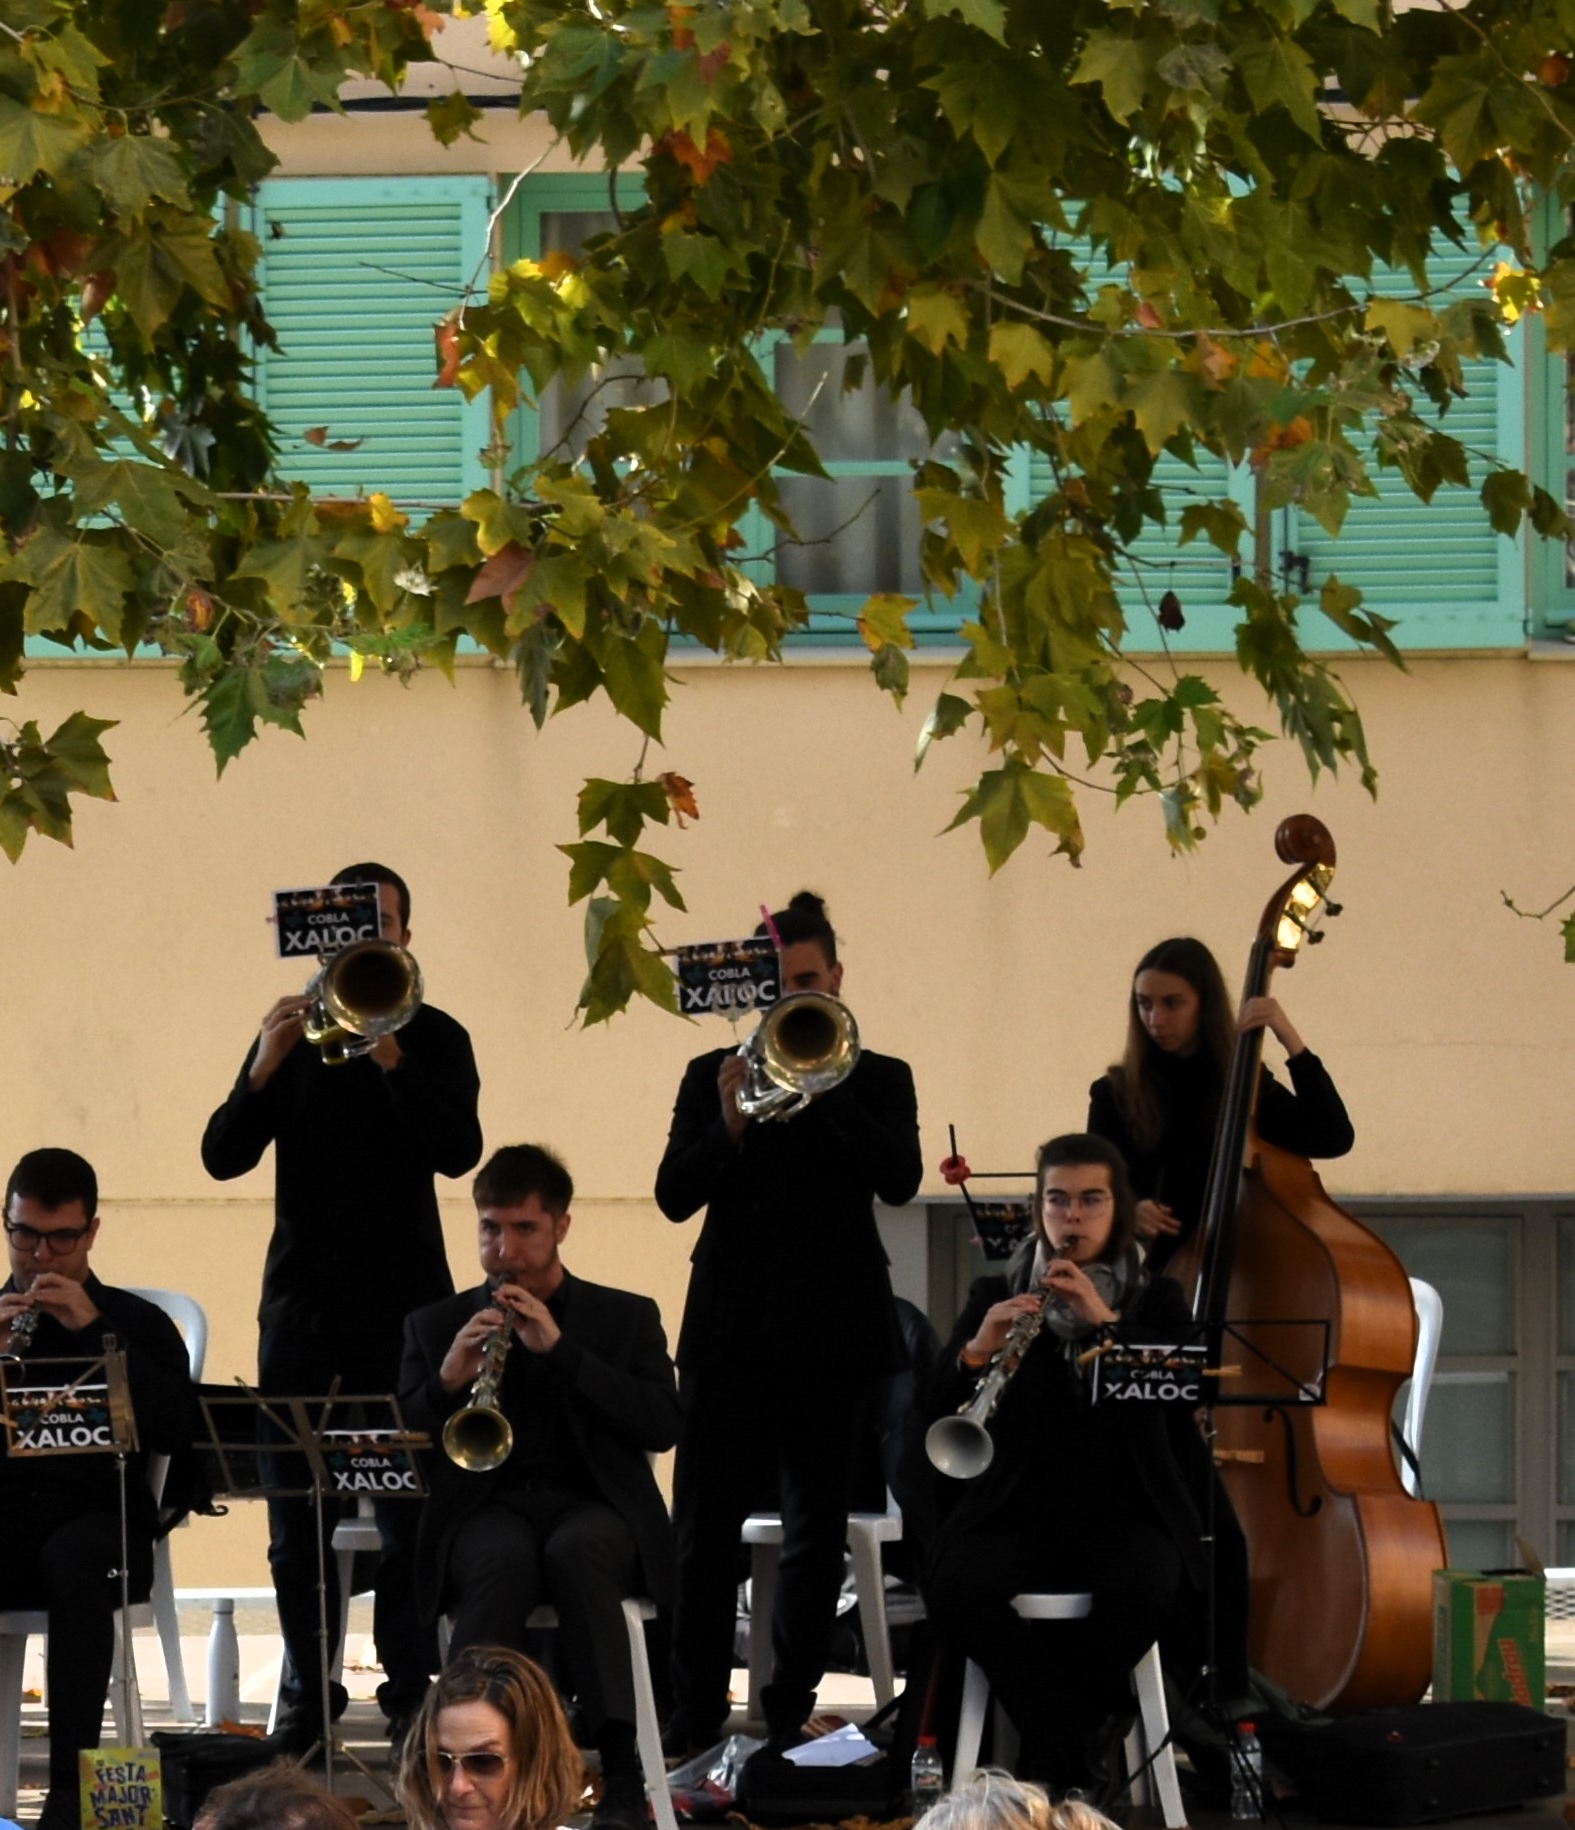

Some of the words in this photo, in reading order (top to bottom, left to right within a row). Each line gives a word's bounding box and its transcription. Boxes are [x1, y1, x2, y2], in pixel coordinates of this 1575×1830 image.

[307, 912, 350, 925] COBLA
[708, 967, 751, 980] COBLA
[40, 1413, 85, 1425] COBLA
[350, 1458, 392, 1469] COBLA
[332, 1471, 418, 1491] XALOC
[95, 1762, 146, 1784] FESTA
[90, 1785, 152, 1808] MAJOR
[94, 1804, 149, 1830] SANT
